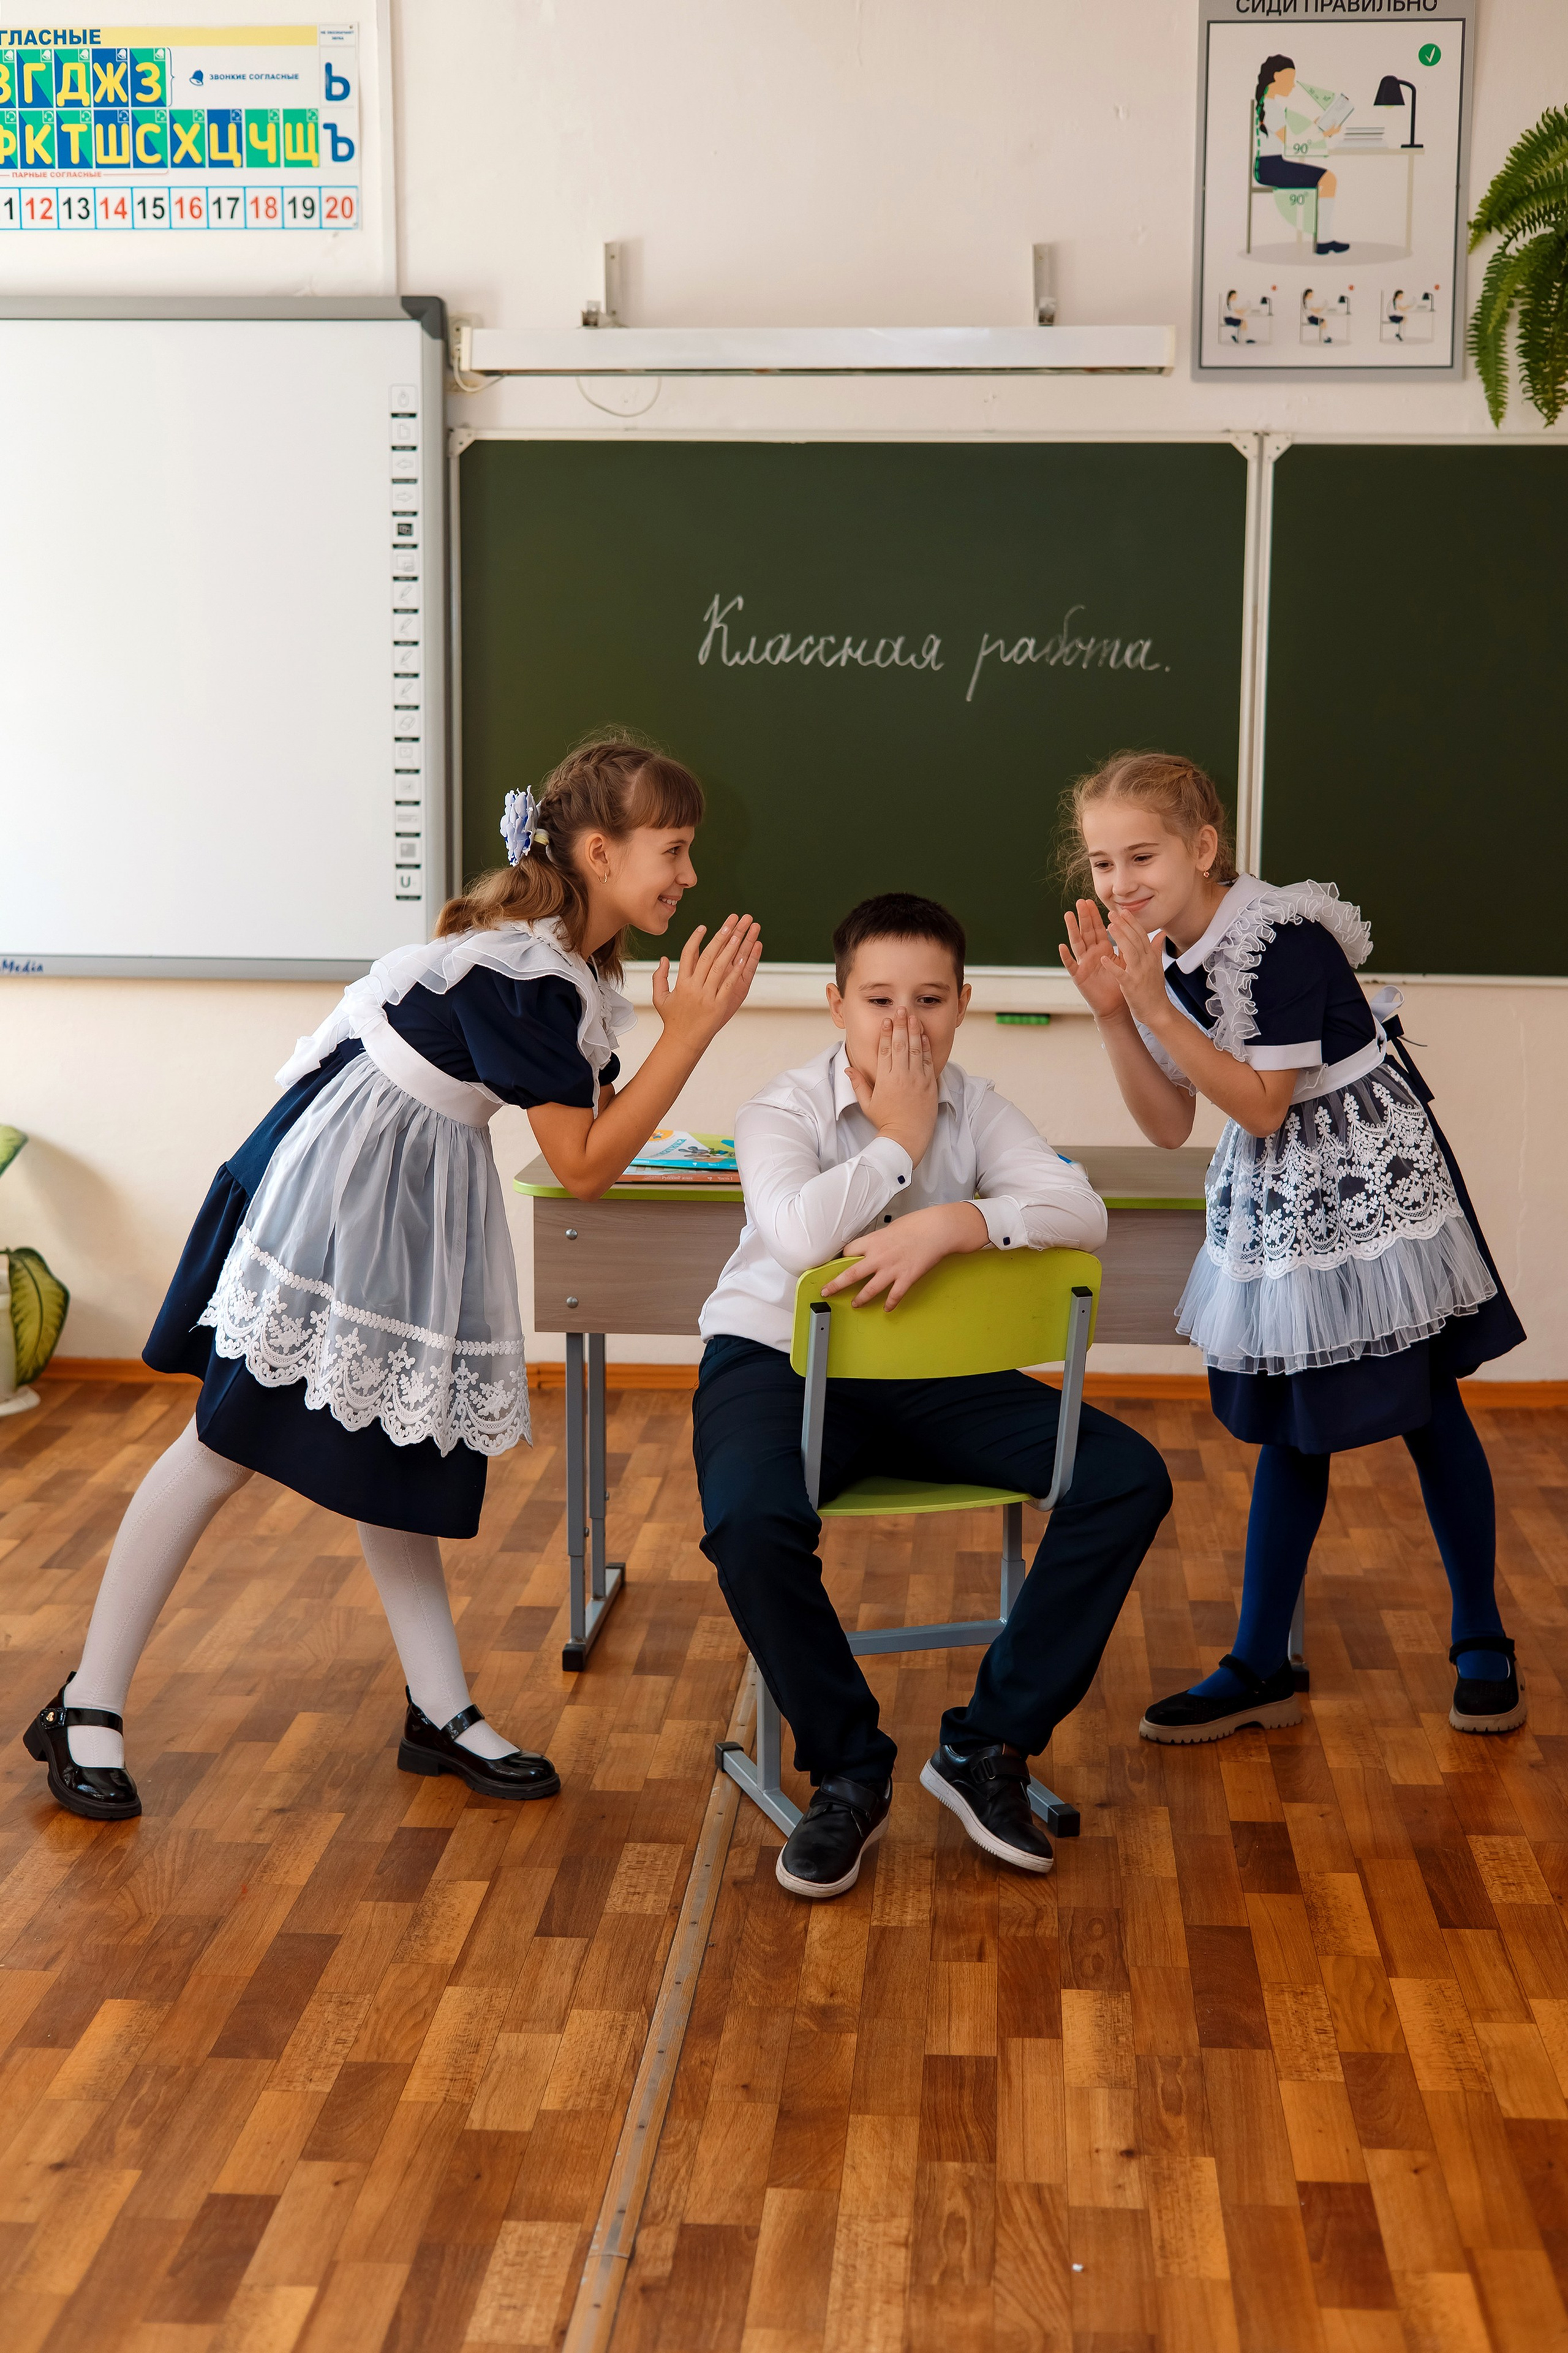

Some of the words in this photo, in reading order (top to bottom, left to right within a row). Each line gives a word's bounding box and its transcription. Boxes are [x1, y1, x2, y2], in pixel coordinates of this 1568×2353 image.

[1236, 0, 1297, 17] СИДИ
[1304, 0, 1438, 13] ПРАВИЛЬНО
[23, 63, 46, 104] Г
[57, 62, 91, 107] Д
[93, 62, 128, 103] Ж
[134, 62, 162, 103] З
[325, 62, 351, 101] Ь
[25, 124, 53, 165] К
[61, 123, 88, 164] Т
[96, 123, 130, 164] Ш
[135, 123, 162, 164] С
[173, 123, 200, 164] Х
[210, 123, 242, 168] Ц
[249, 123, 277, 164] Ч
[284, 122, 319, 168] Щ
[323, 123, 355, 162] Ъ
[25, 197, 53, 220] 12
[62, 197, 91, 220] 13
[100, 197, 127, 220] 14
[137, 197, 165, 220] 15
[175, 197, 203, 220] 16
[213, 197, 239, 220] 17
[250, 197, 277, 220] 18
[288, 197, 315, 220] 19
[325, 197, 354, 220] 20
[698, 592, 945, 672] Классная
[965, 603, 1172, 703] работа.
